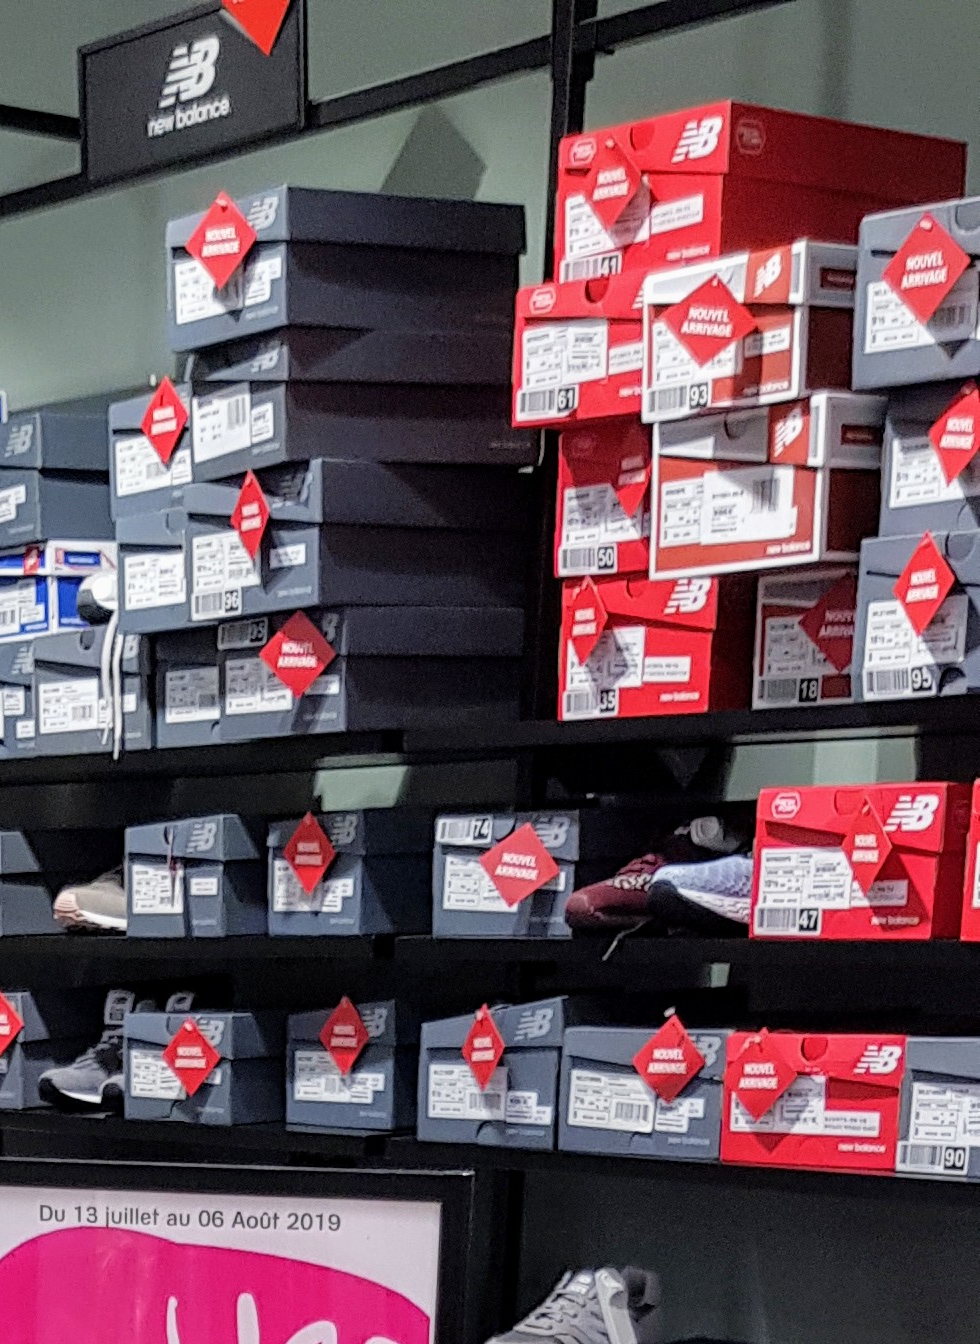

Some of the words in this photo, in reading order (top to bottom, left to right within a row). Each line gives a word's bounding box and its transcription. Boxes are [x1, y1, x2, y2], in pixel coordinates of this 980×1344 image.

[147, 115, 175, 137] new
[175, 96, 230, 129] balance
[905, 250, 944, 272] NOUVEL
[901, 267, 948, 290] ARRIVAGE
[688, 307, 729, 322] NOUVEL
[681, 320, 733, 338] ARRIVAGE
[558, 388, 575, 409] 61
[690, 386, 708, 407] 93
[598, 548, 614, 568] 50
[801, 680, 818, 699] 18
[799, 909, 818, 929] 47
[743, 1062, 775, 1076] NOUVEL
[738, 1076, 778, 1090] ARRIVAGE
[945, 1149, 965, 1168] 90
[39, 1204, 66, 1223] Du
[74, 1206, 99, 1224] 13
[105, 1206, 160, 1228] juillet
[167, 1212, 190, 1228] au
[198, 1210, 225, 1228] 06
[231, 1209, 280, 1230] Août
[286, 1213, 342, 1232] 2019
